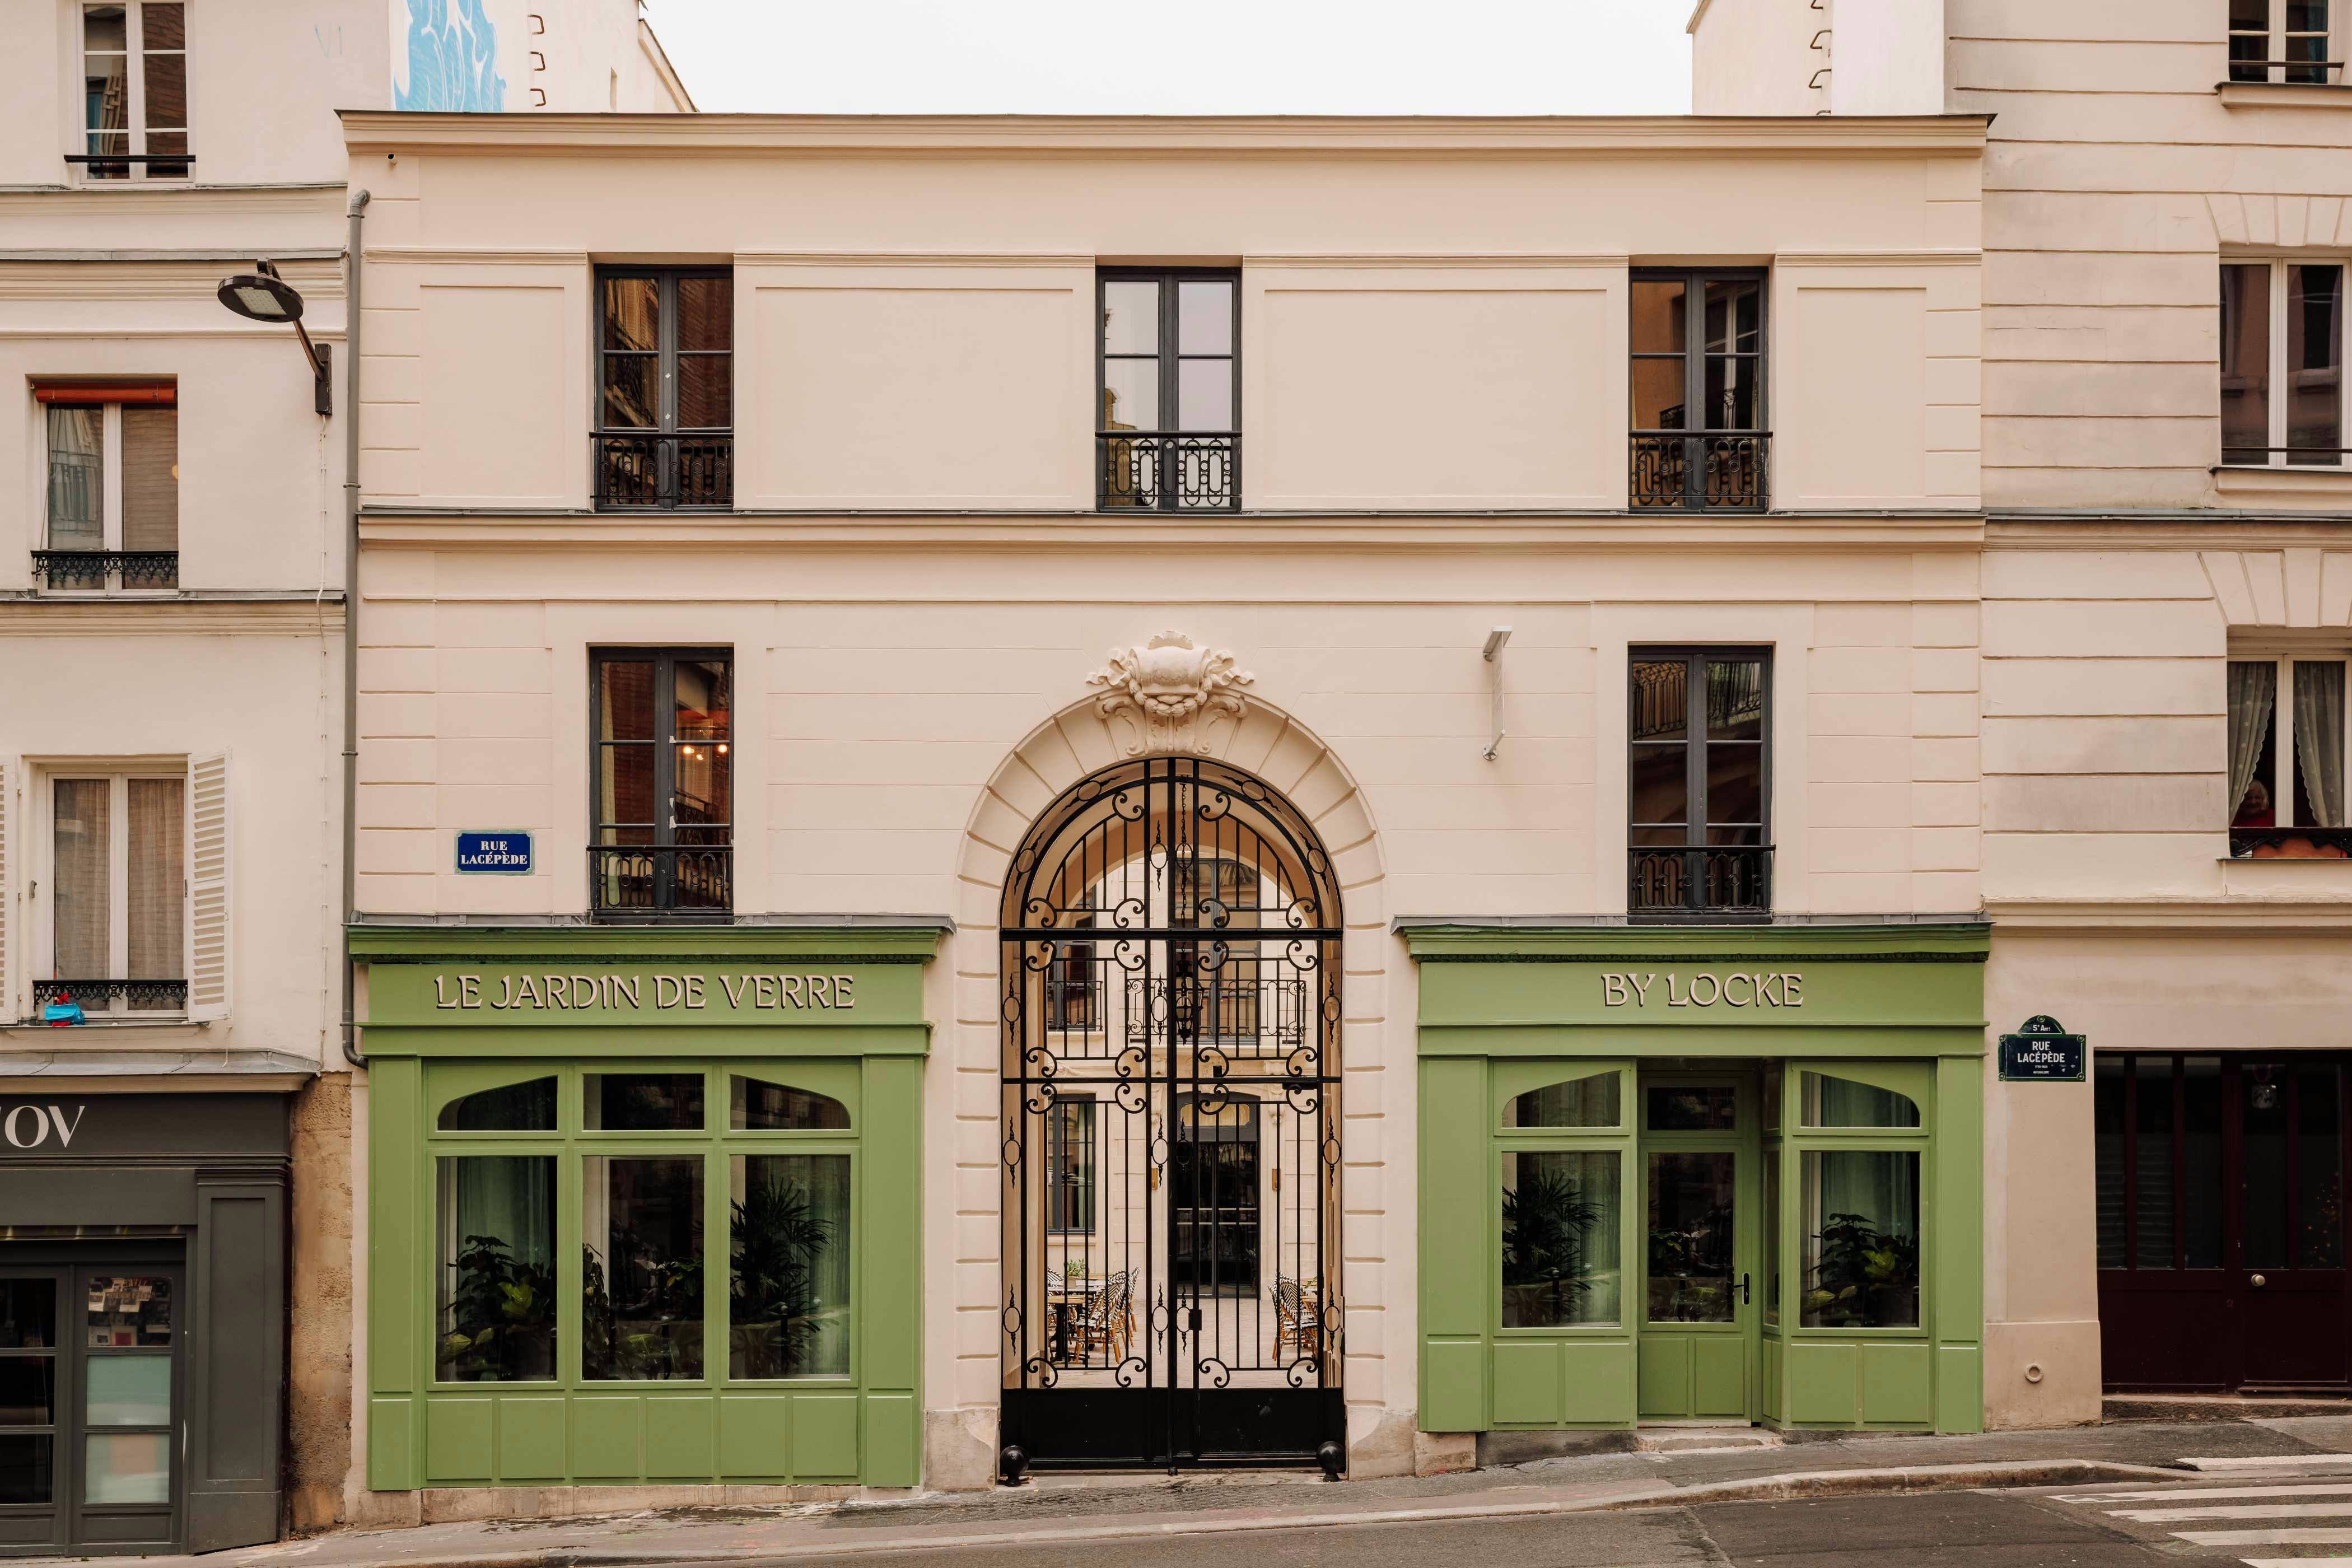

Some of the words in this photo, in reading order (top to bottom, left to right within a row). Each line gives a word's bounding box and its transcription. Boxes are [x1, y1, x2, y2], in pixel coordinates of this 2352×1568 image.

[480, 841, 507, 851] RUE
[461, 851, 528, 865] LACÉPÈDE
[435, 975, 483, 1009] LE
[492, 975, 640, 1010] JARDIN
[653, 975, 707, 1009] DE
[719, 975, 856, 1009] VERRE
[1601, 973, 1656, 1007] BY
[1665, 973, 1804, 1008] LOCKE
[2032, 1041, 2051, 1051] RUE
[2018, 1051, 2065, 1063] LACÉPÈDE
[0, 1105, 86, 1148] OV
